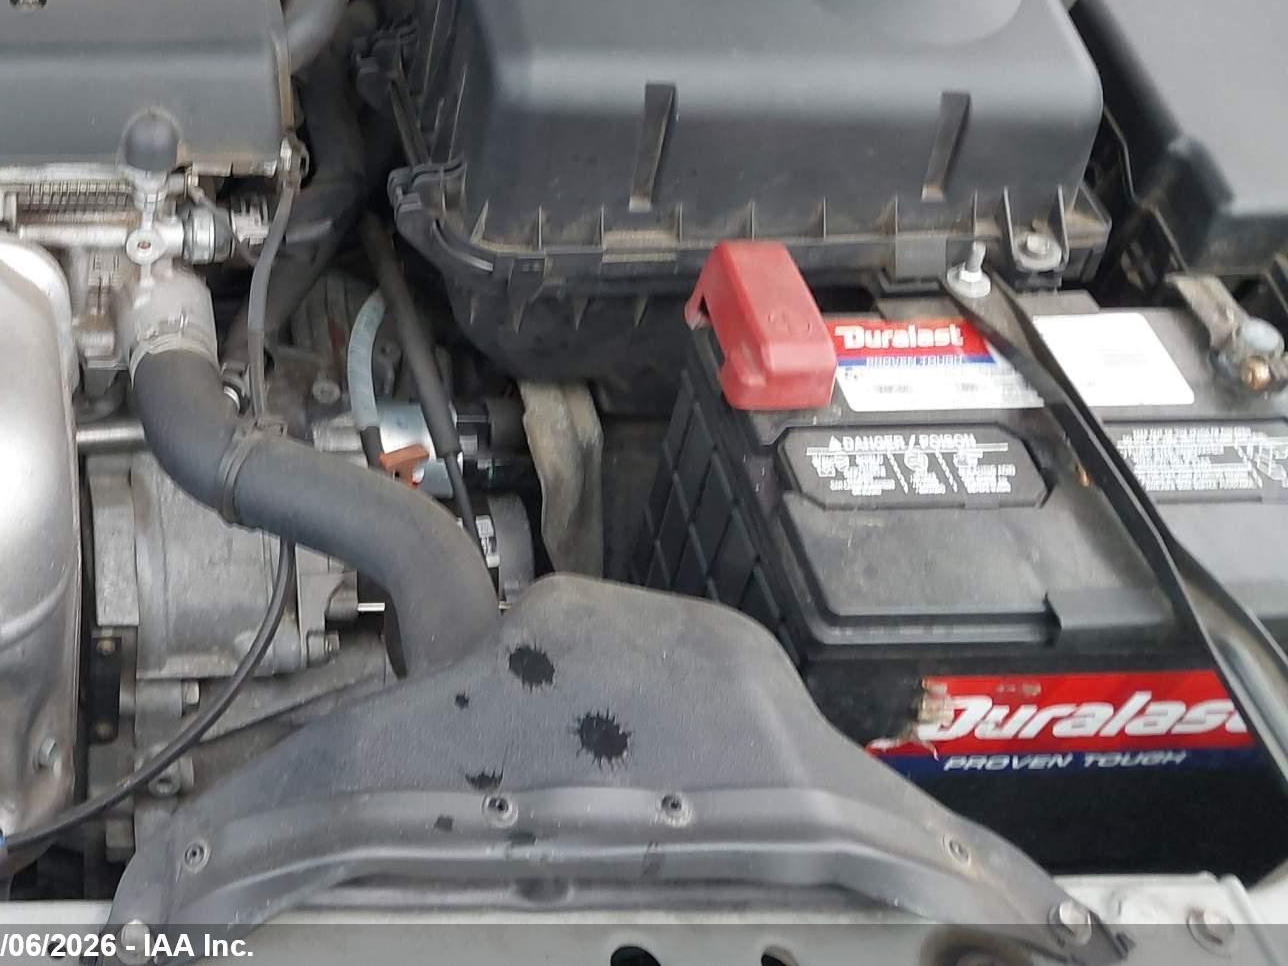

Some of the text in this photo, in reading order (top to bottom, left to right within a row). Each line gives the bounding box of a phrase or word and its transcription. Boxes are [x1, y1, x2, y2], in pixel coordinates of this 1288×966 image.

[835, 323, 963, 349] Duralast
[842, 435, 905, 451] DANGER
[918, 691, 1248, 740] Duralas
[943, 751, 1187, 771] PROVEN TOUGH
